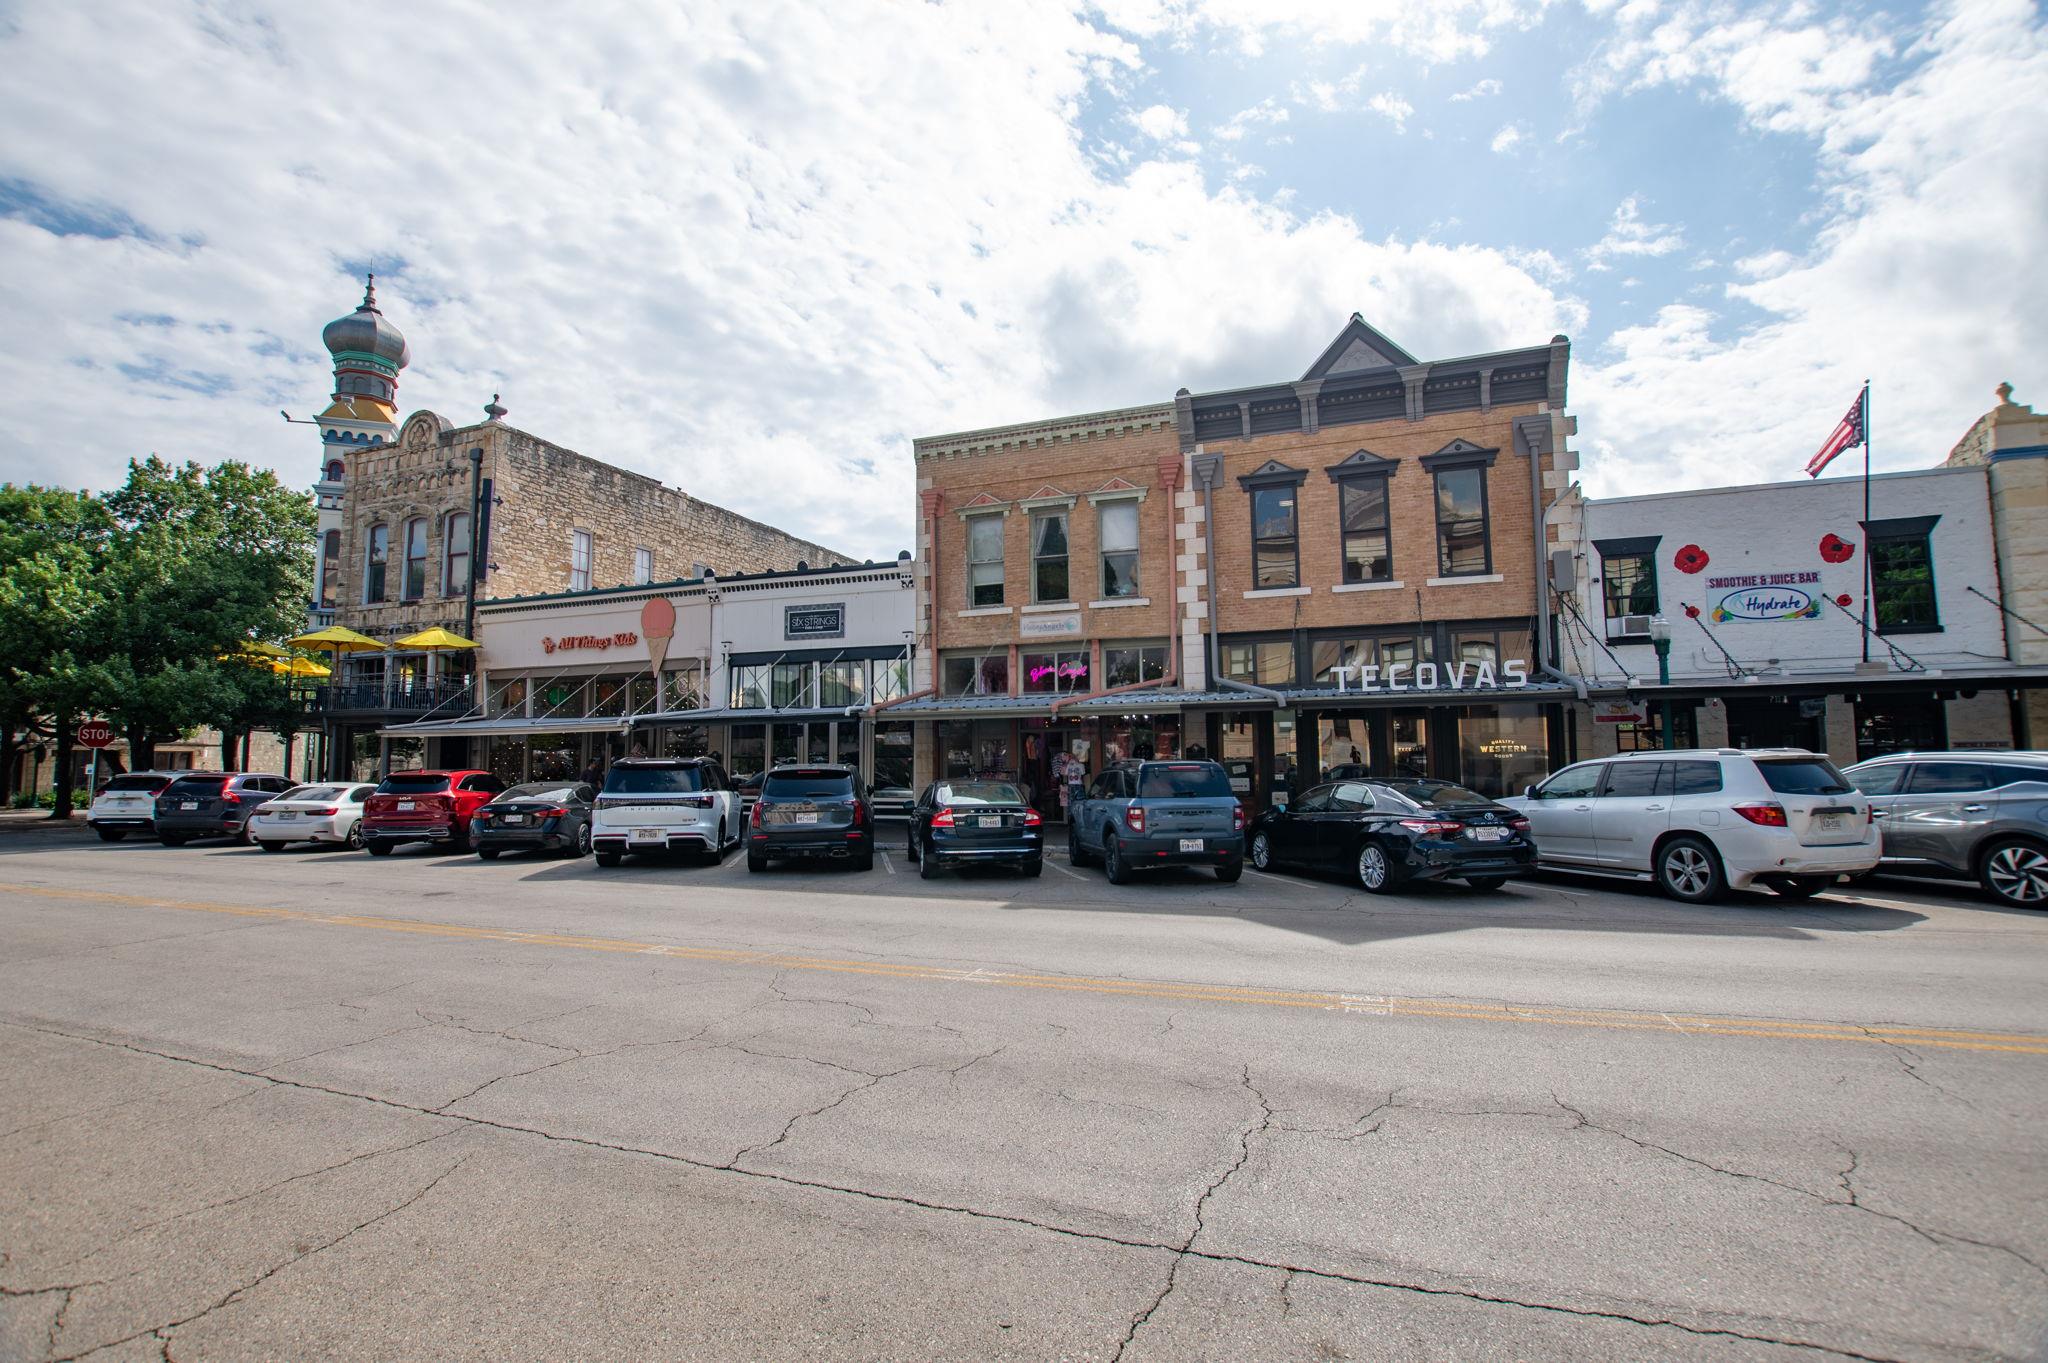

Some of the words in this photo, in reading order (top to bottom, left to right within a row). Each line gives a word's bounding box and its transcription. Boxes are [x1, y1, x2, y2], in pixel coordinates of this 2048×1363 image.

[1709, 575, 1757, 588] SMOOTHIE
[1760, 575, 1767, 585] &
[1769, 573, 1796, 585] JUICE
[1799, 572, 1819, 583] BAR
[1746, 595, 1801, 616] Hydrate
[804, 616, 837, 627] STRINGS
[558, 636, 575, 649] All
[575, 635, 611, 650] Things
[612, 632, 638, 646] Kids
[1330, 659, 1527, 692] TECOVAS
[81, 729, 113, 740] STOP
[1480, 745, 1527, 753] WESTERN
